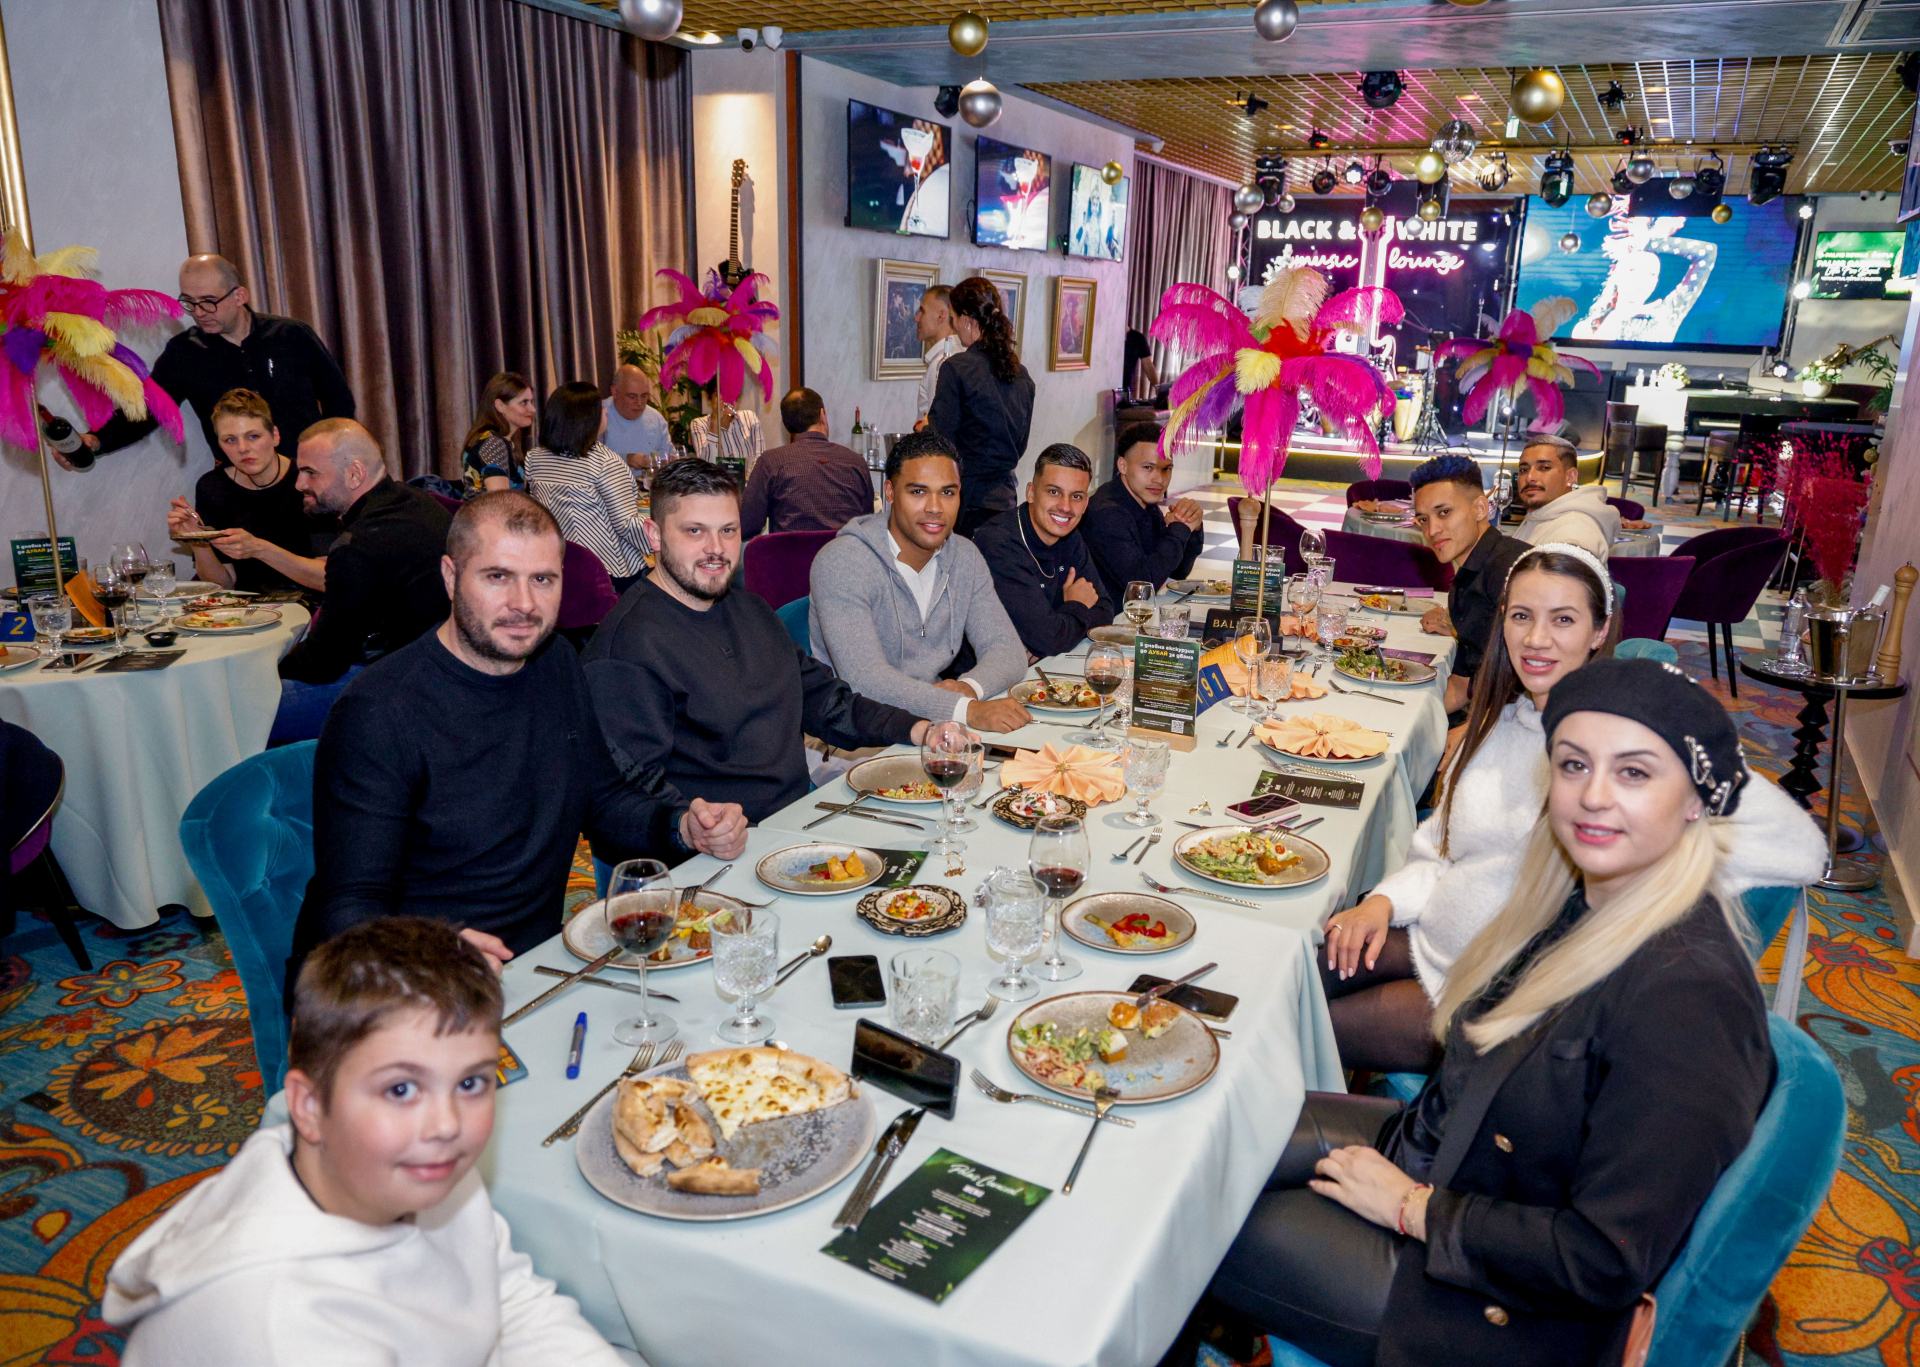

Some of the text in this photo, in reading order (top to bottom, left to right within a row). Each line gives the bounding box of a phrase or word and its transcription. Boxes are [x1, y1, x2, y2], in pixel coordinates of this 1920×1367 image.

[1257, 219, 1478, 241] BLACK & WHITE
[1288, 246, 1465, 275] music lounge
[10, 616, 27, 635] 2
[1148, 649, 1168, 657] ДУБАЙ
[1165, 645, 1195, 654] екскурзия
